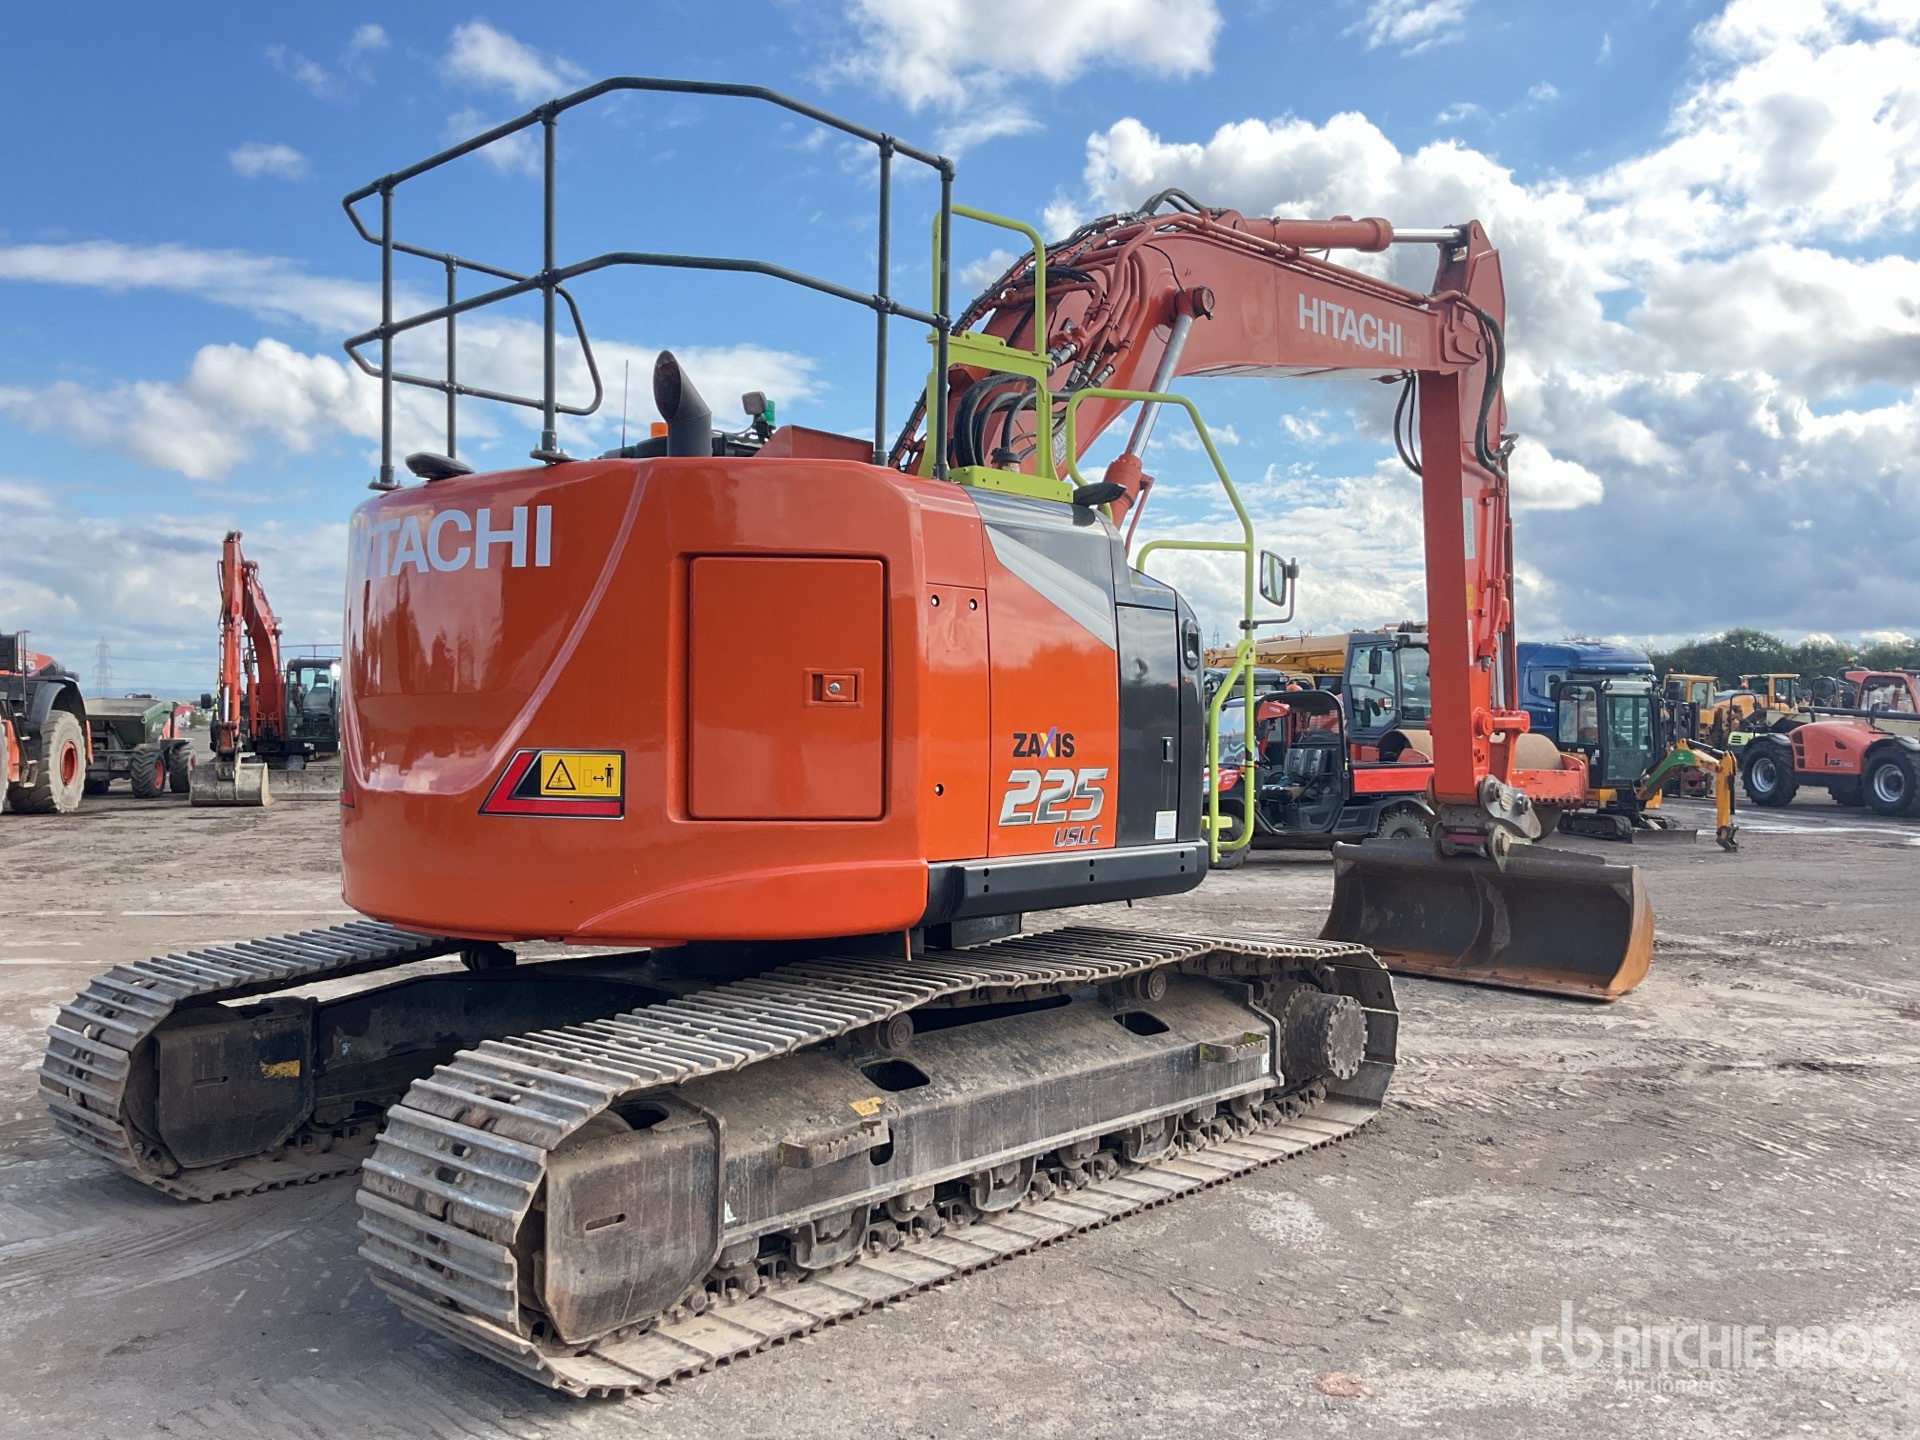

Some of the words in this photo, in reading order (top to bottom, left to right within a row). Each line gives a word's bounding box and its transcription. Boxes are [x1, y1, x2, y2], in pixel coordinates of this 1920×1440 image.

[1298, 293, 1402, 357] HITACHI
[1012, 726, 1075, 758] ZAXIS
[998, 767, 1109, 826] 225
[1054, 825, 1102, 847] USLC
